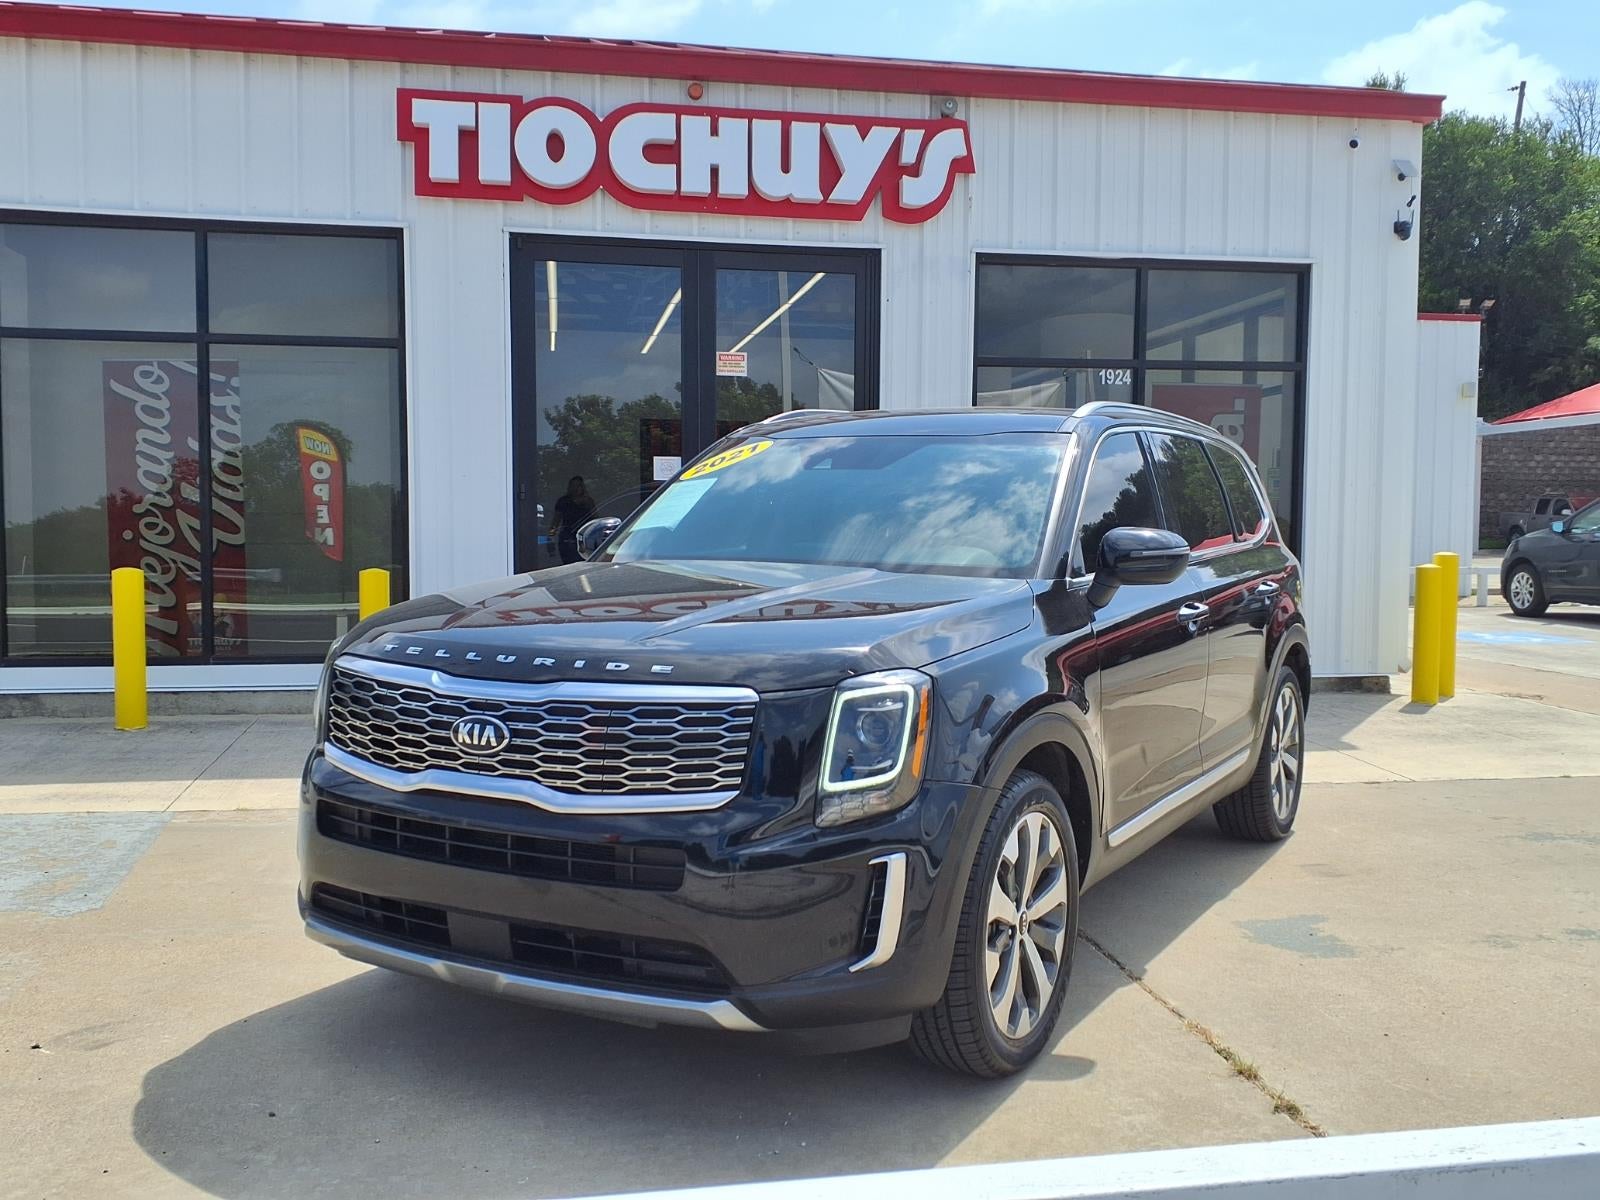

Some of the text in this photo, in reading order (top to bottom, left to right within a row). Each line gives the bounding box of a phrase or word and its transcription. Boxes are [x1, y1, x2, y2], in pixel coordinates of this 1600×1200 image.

[411, 97, 968, 210] TIO CHUY'S
[1098, 369, 1132, 385] 1924
[691, 443, 759, 476] 2021
[383, 644, 675, 674] TELLURIDE
[456, 722, 498, 746] KIA
